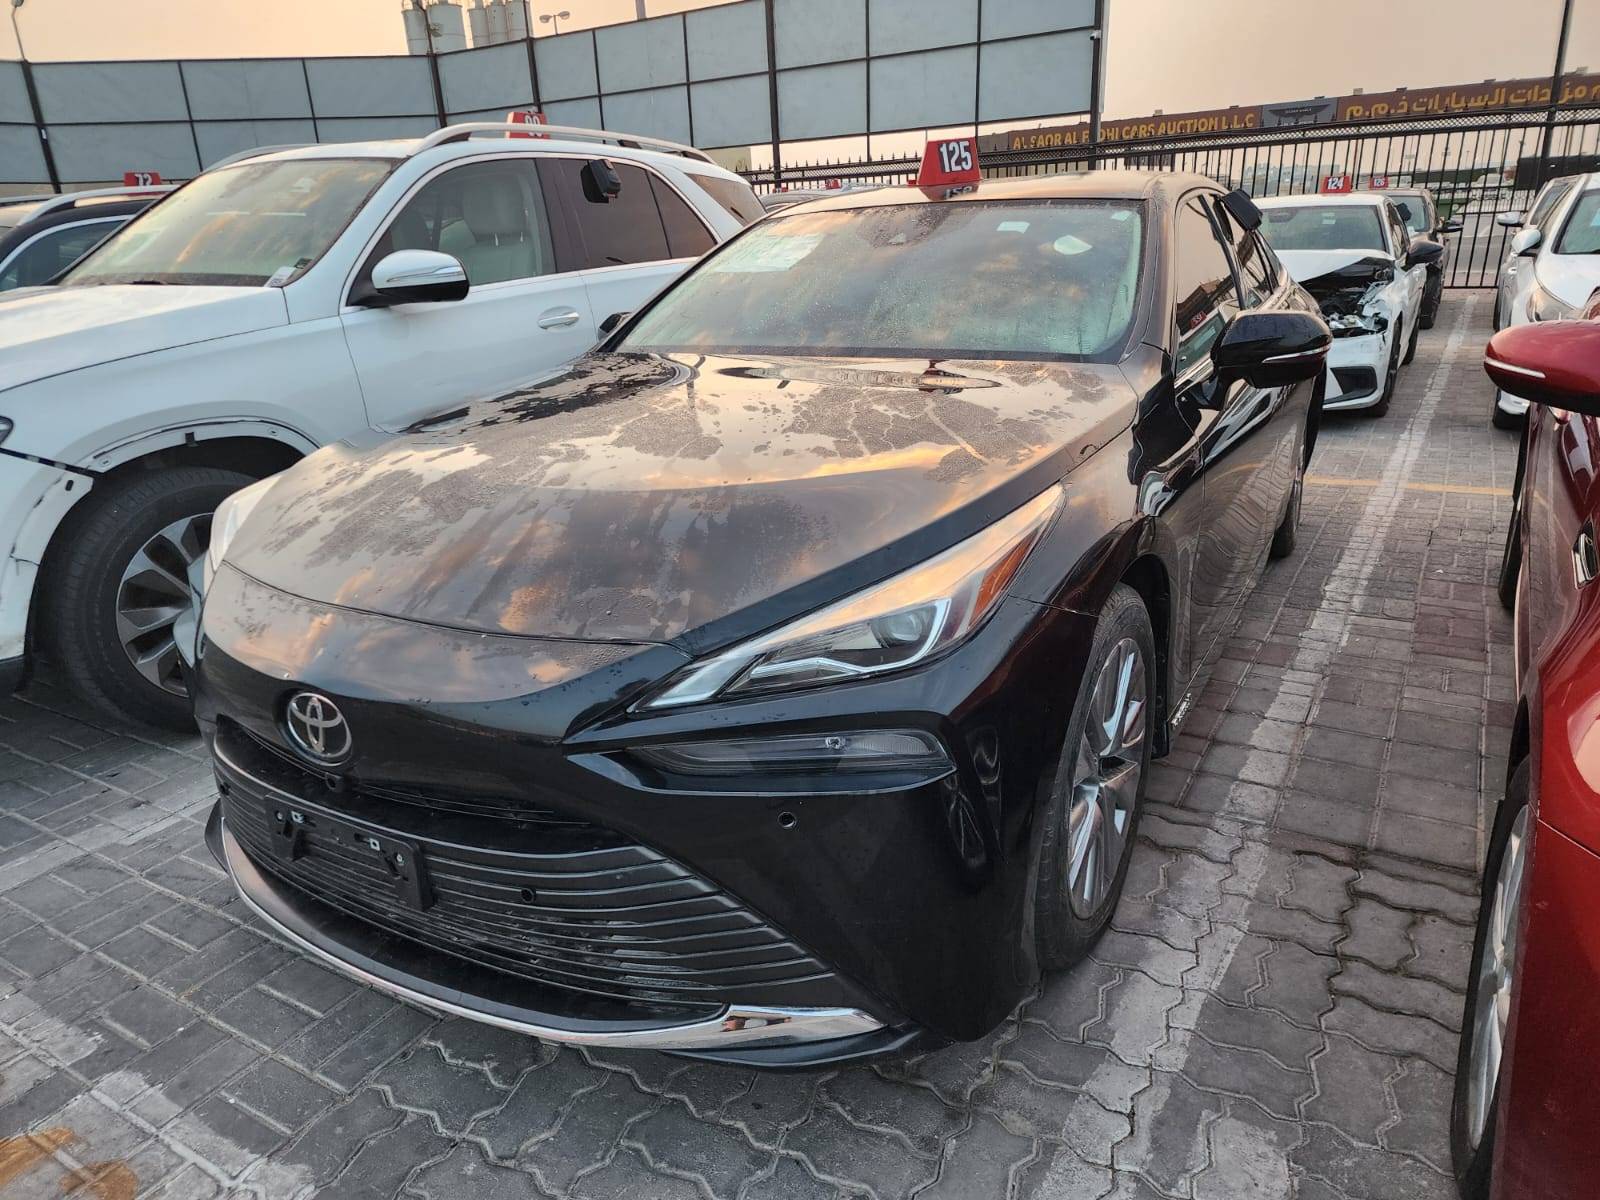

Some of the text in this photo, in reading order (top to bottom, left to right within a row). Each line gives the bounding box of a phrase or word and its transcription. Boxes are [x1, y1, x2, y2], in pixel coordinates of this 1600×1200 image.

[1509, 82, 1587, 105] مزدات
[1013, 136, 1027, 150] AL
[1064, 131, 1078, 146] AL
[1122, 123, 1155, 139] CARS
[1158, 117, 1218, 136] AUCTION
[940, 140, 973, 173] 125
[1327, 176, 1345, 190] 124
